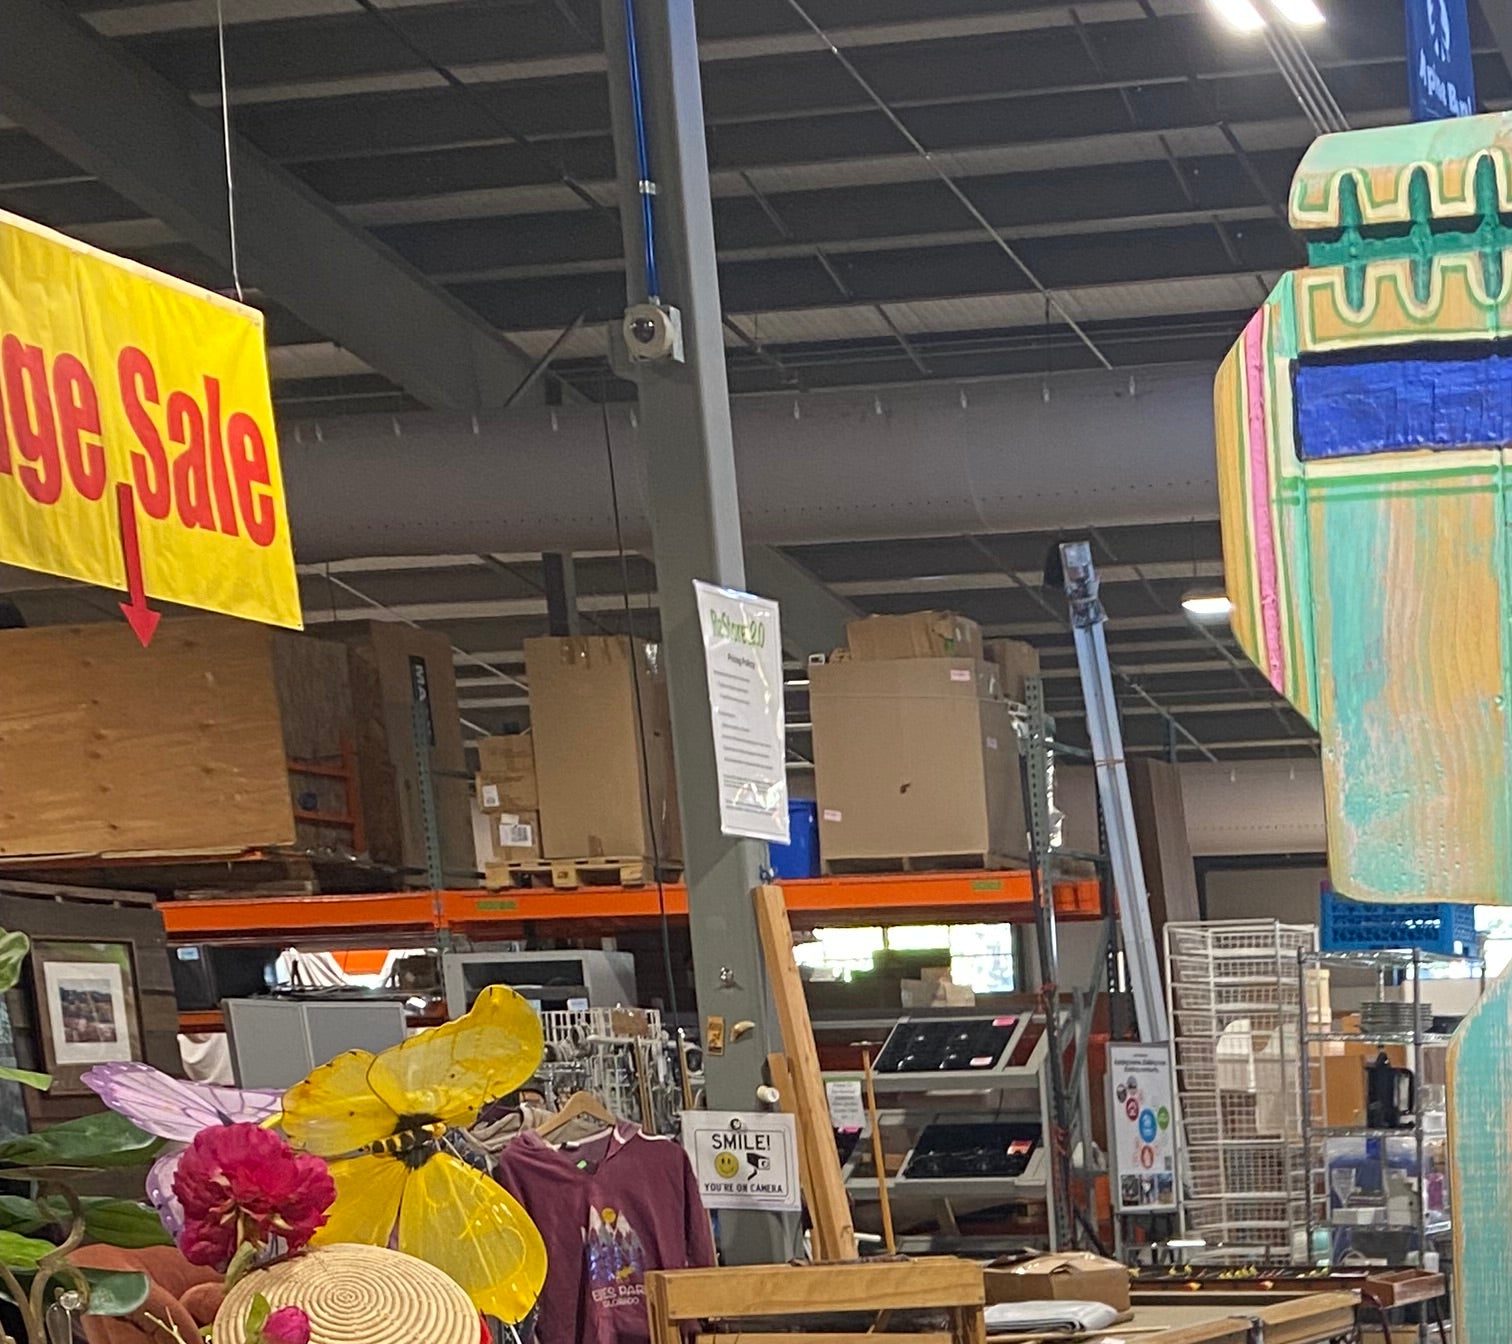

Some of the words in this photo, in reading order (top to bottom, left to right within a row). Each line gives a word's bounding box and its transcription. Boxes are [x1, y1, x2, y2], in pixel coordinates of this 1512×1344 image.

[0, 334, 107, 505] ge
[118, 346, 276, 547] Sale
[712, 1133, 771, 1151] SMILE!
[736, 1184, 748, 1192] ON
[749, 1184, 783, 1193] CAMERA
[618, 1284, 645, 1297] PAR
